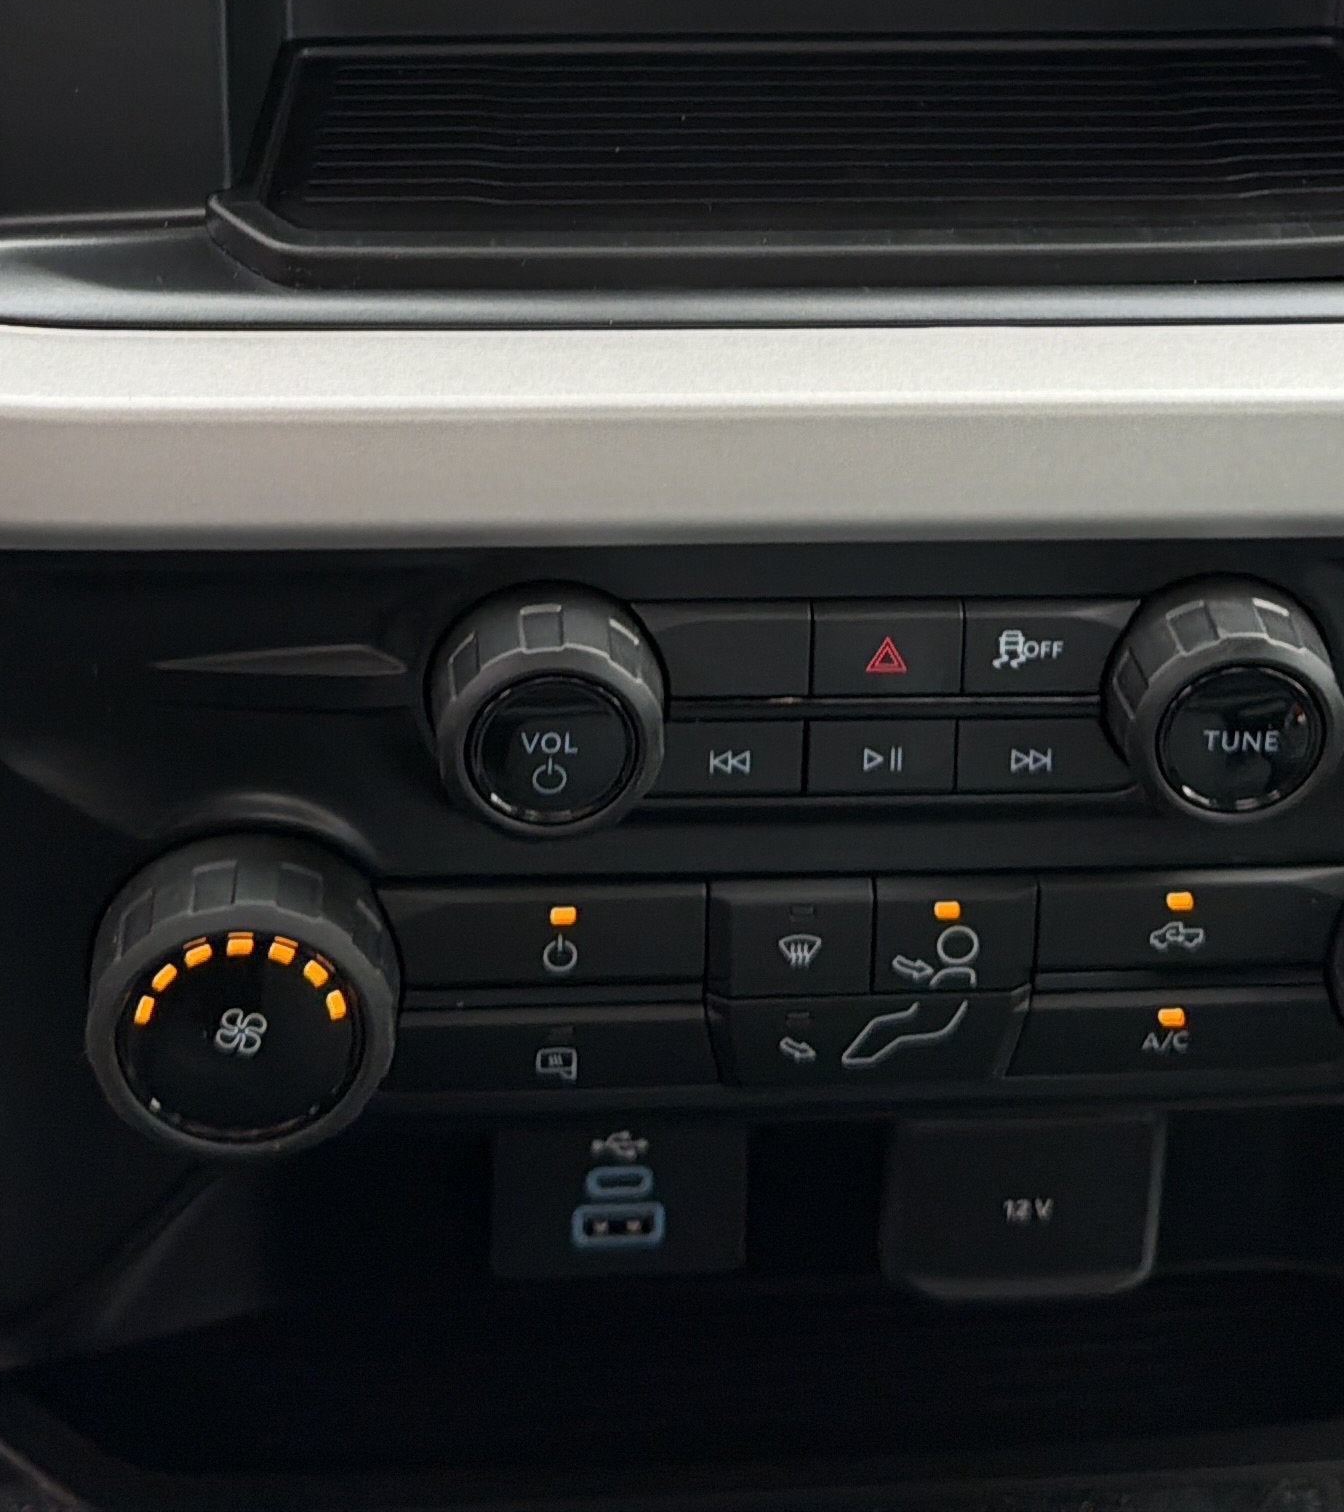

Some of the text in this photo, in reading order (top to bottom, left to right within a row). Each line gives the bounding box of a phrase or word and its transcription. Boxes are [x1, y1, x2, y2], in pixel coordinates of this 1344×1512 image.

[1023, 640, 1064, 659] OFF
[521, 730, 579, 756] VOL
[1203, 729, 1280, 754] TUNE
[1142, 1029, 1190, 1055] A/C
